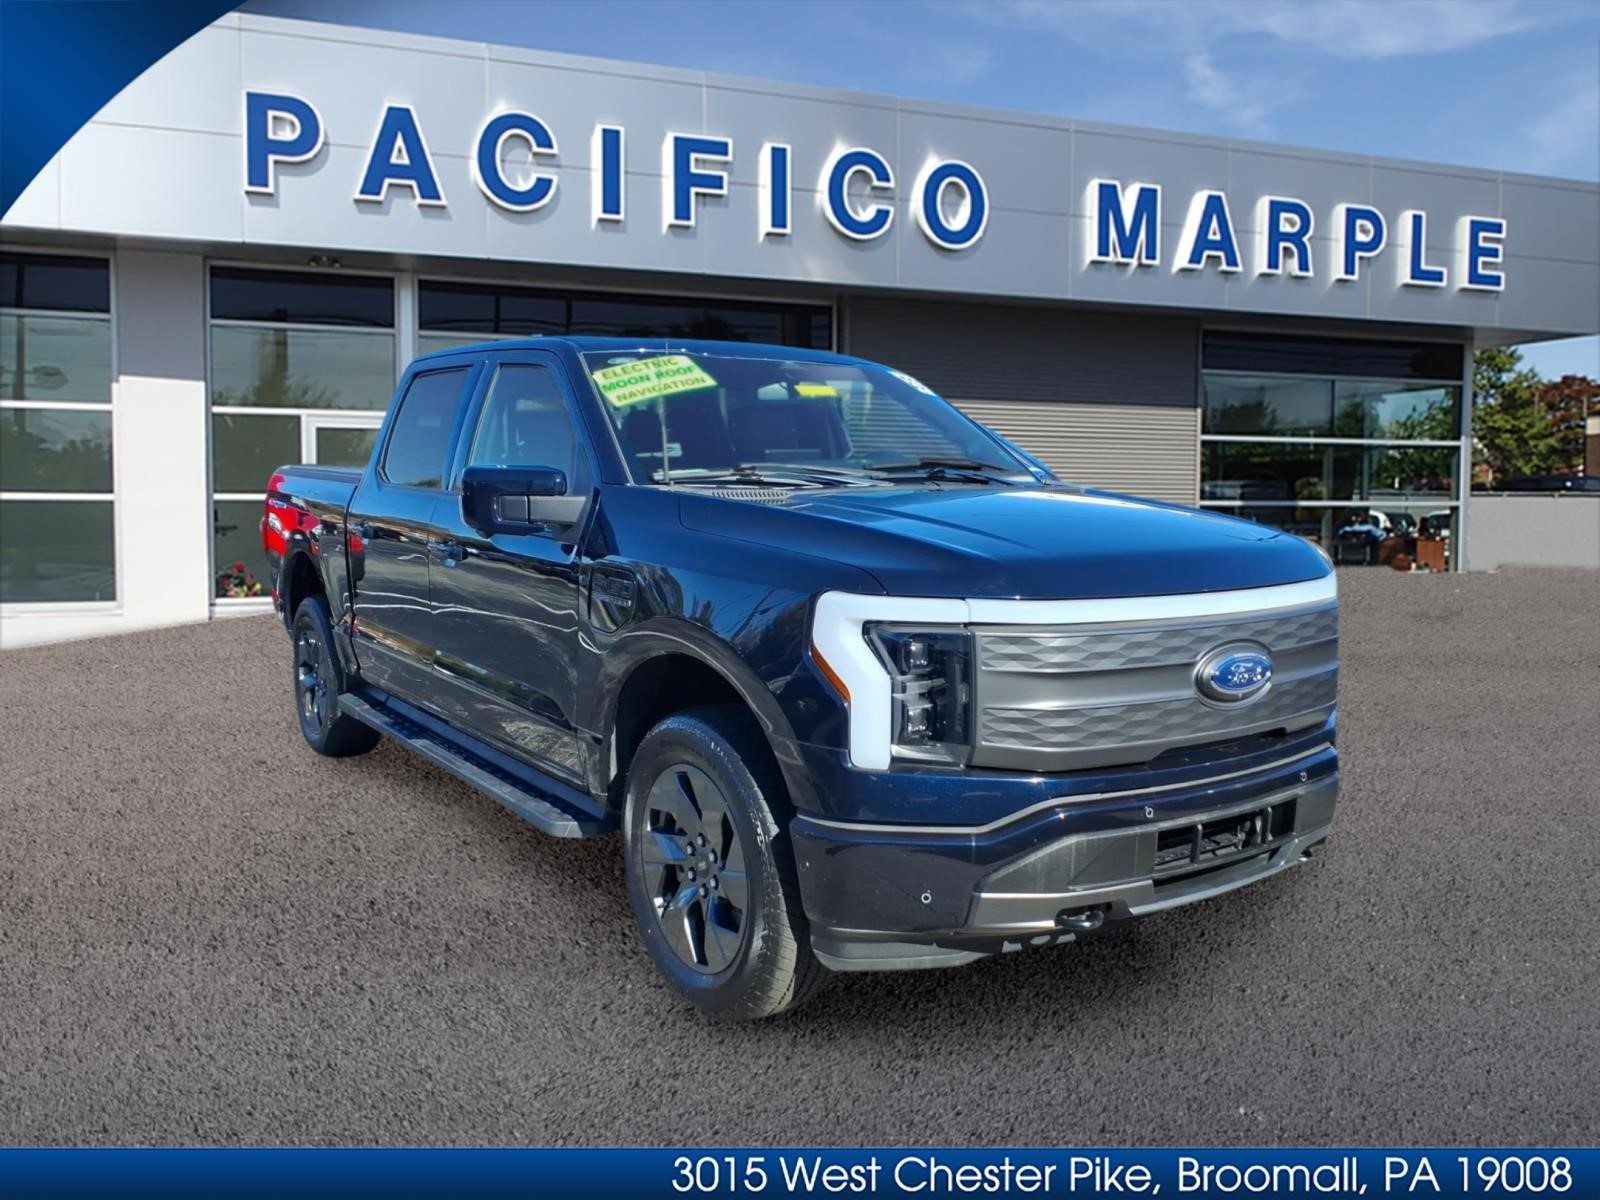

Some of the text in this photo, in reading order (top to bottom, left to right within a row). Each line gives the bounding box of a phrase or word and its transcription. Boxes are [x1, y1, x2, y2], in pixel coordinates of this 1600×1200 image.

[244, 89, 1506, 292] PACIFICO MARPLE
[601, 356, 679, 380] ELECTRIC
[601, 365, 696, 393] MOON ROOF
[615, 376, 707, 402] NAVIGATION
